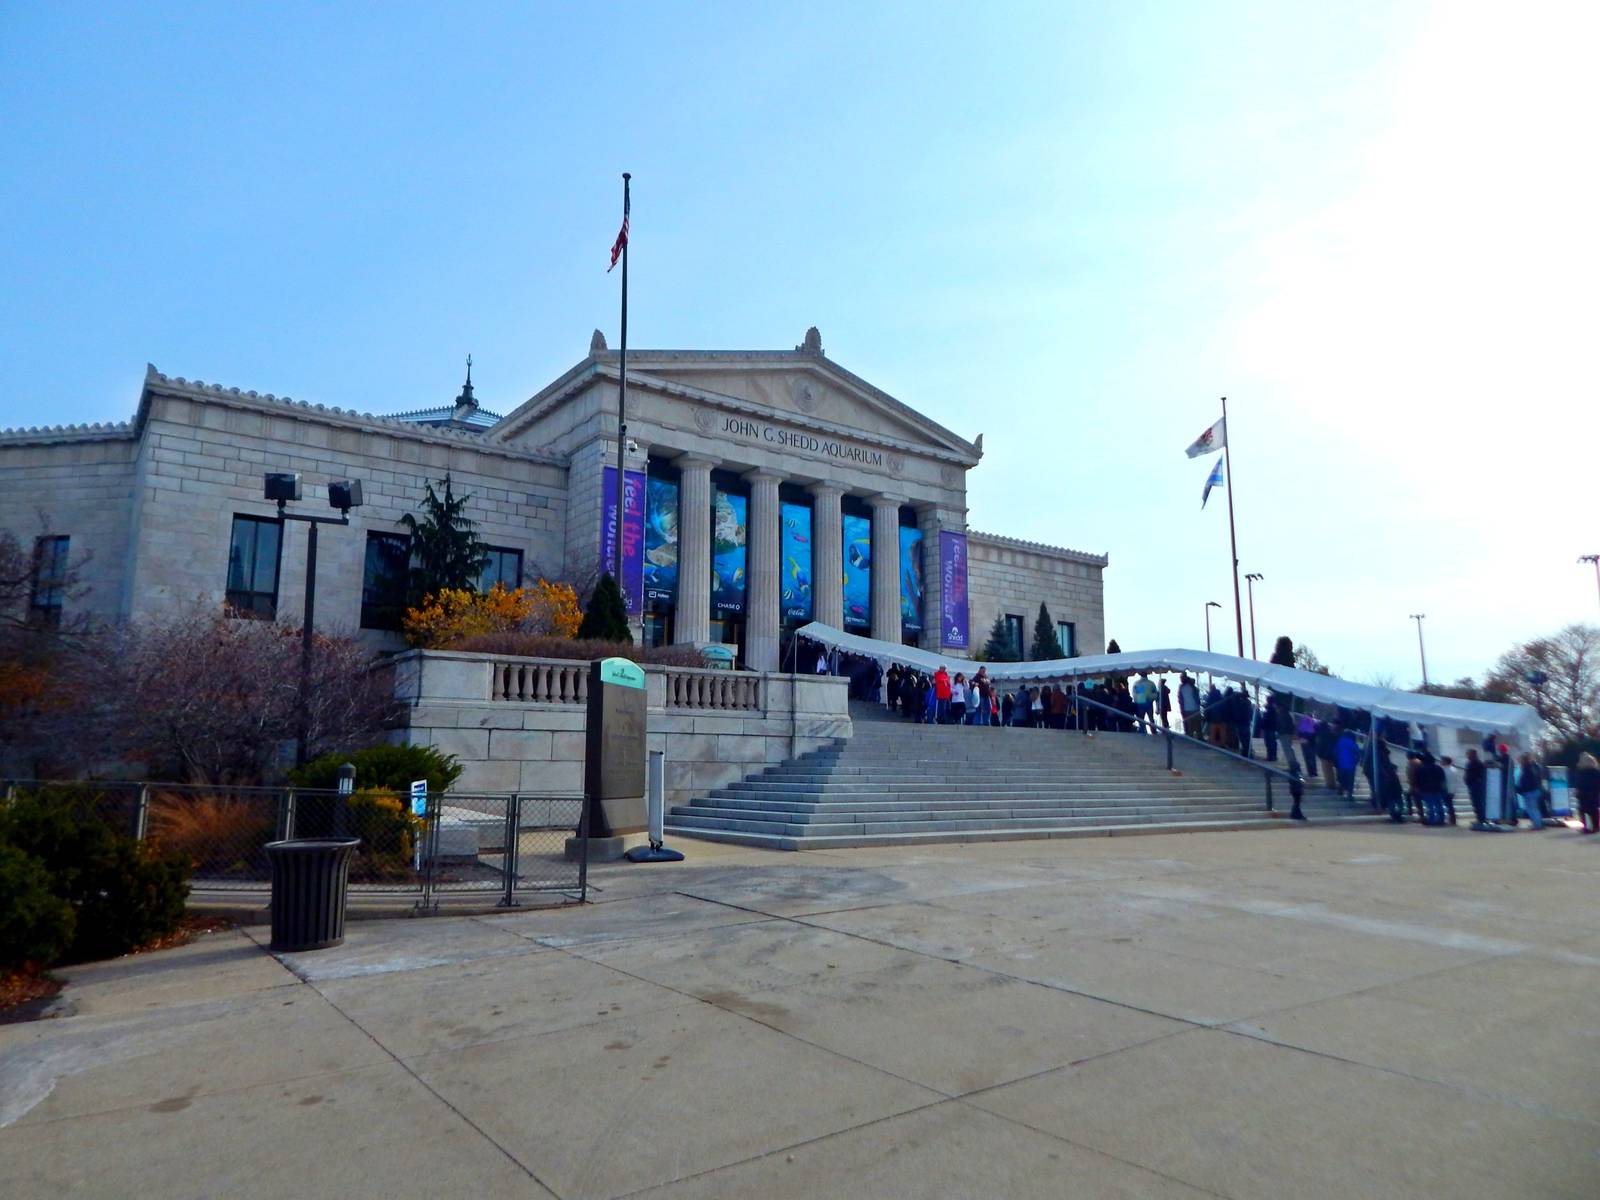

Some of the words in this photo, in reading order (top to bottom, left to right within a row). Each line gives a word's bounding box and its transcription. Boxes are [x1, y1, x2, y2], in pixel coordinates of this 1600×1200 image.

[722, 418, 759, 438] JOHN
[763, 427, 776, 442] G.
[778, 431, 819, 451] SHEDD
[822, 441, 882, 466] AQUARIUM
[624, 477, 641, 516] feel
[623, 521, 640, 556] the
[944, 560, 955, 623] wonder
